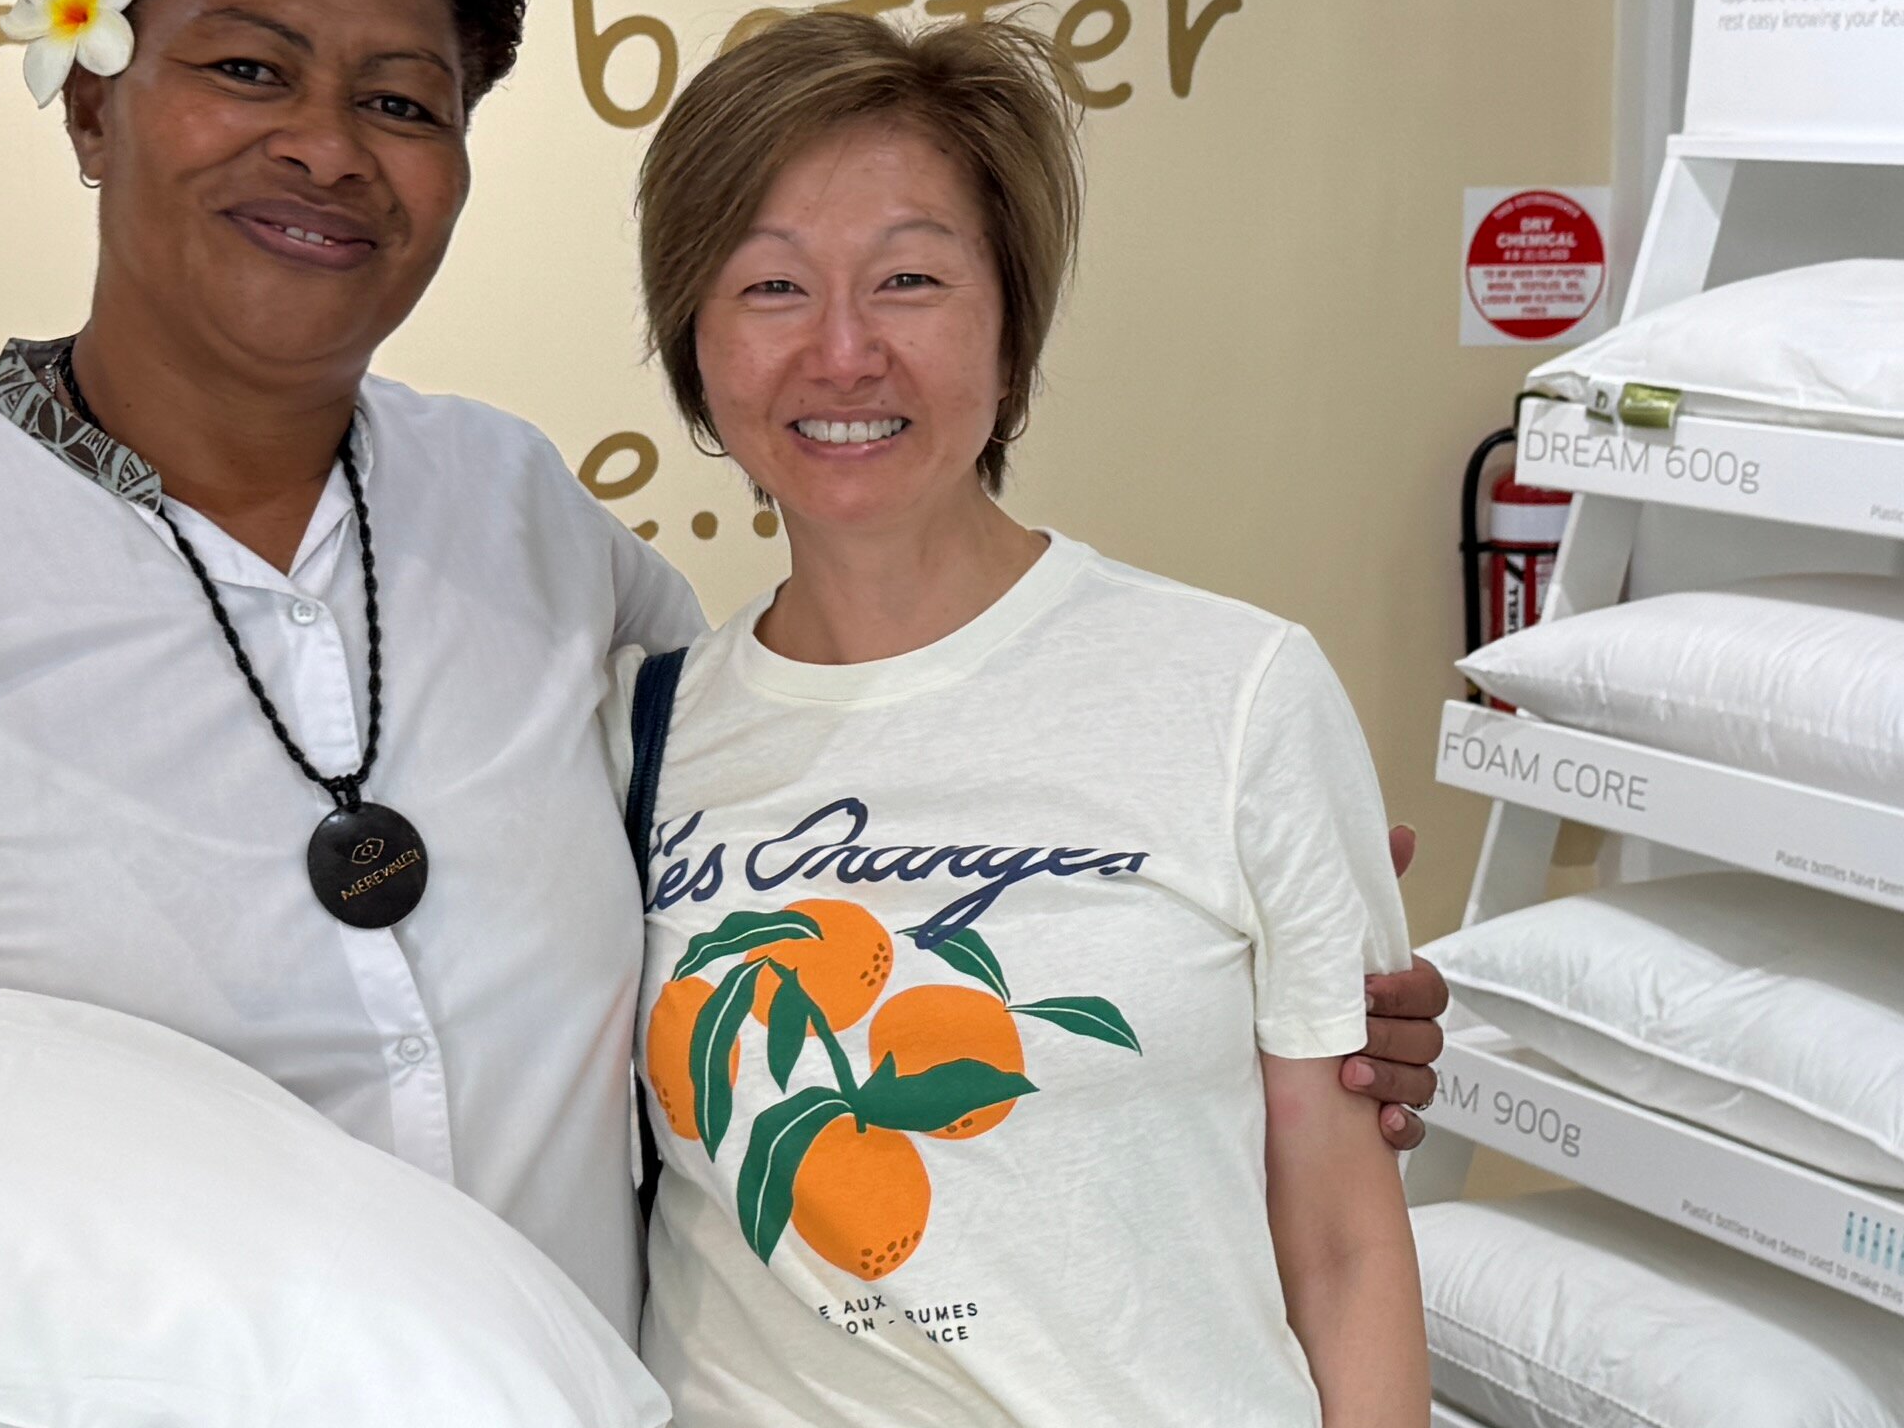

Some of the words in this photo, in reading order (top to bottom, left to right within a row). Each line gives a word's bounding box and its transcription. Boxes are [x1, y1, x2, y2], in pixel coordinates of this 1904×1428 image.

[1495, 232, 1578, 249] CHEMICAL
[1519, 216, 1555, 233] DRY
[1523, 427, 1653, 475] DREAM
[1661, 440, 1761, 496] 600g
[1442, 730, 1542, 785] FOAM
[1552, 757, 1650, 813] CORE
[1492, 1089, 1582, 1159] 900g
[843, 1294, 887, 1315] AUX
